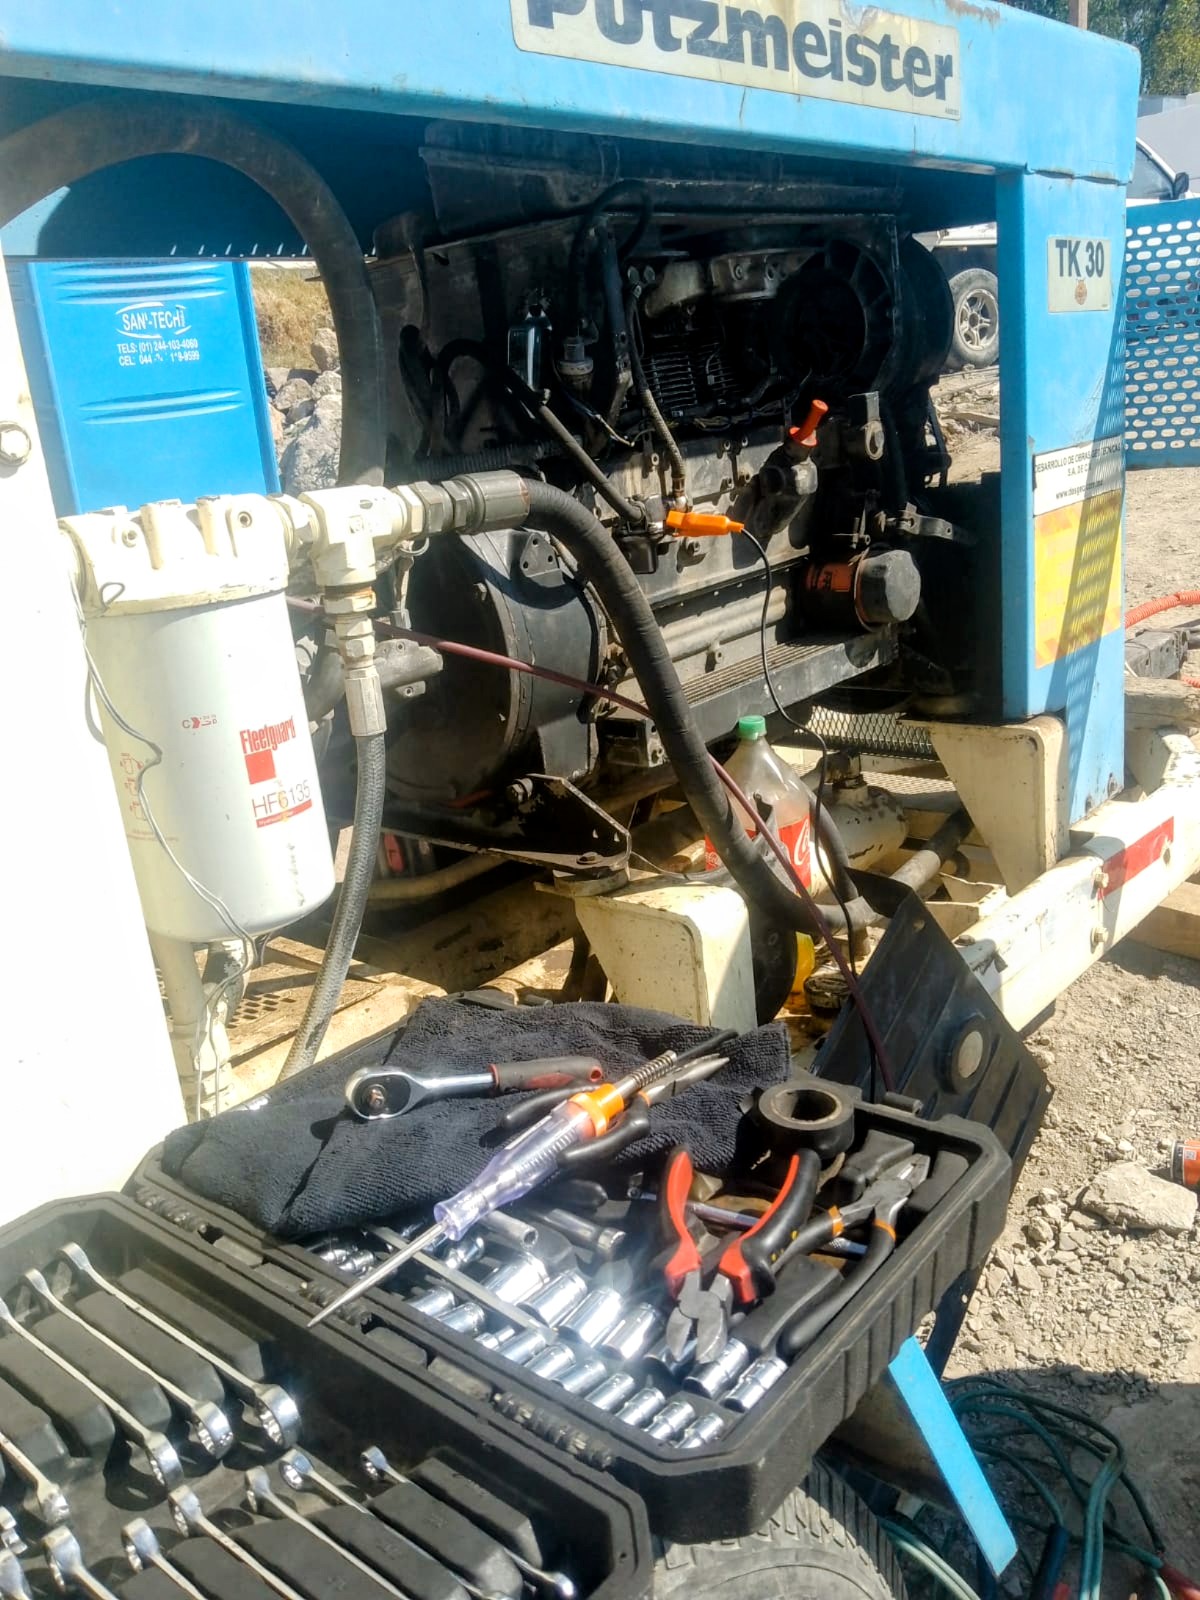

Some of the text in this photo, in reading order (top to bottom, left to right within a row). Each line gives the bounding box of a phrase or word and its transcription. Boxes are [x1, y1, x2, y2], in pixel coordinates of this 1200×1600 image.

[1055, 239, 1104, 278] TK 30
[239, 716, 296, 753] Fleetguard
[252, 780, 311, 817] HF6135
